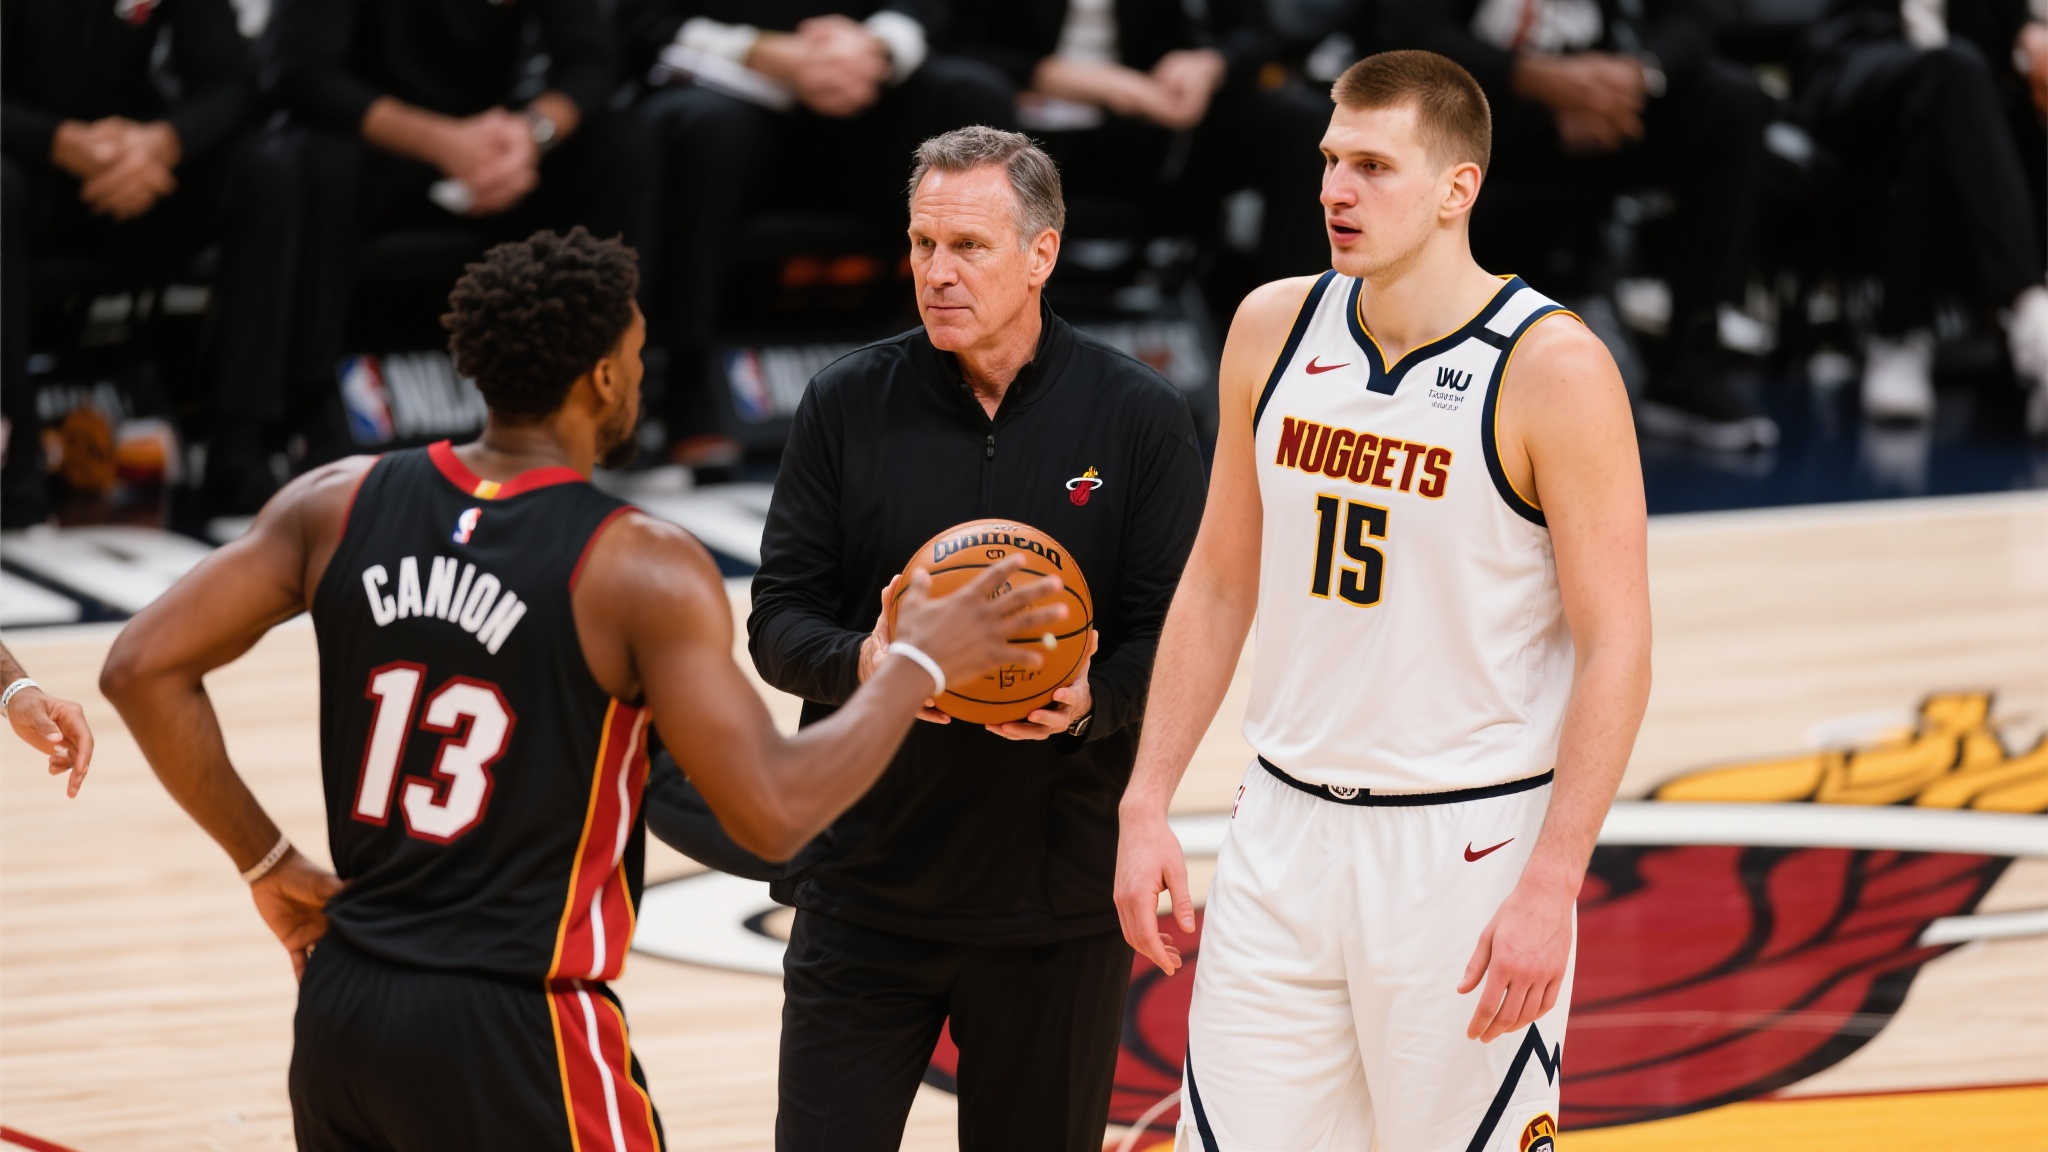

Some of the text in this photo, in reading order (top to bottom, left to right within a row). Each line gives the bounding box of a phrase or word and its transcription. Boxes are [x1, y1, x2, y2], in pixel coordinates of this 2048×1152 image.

[1274, 416, 1453, 500] NUGGETS
[1310, 493, 1390, 608] 15
[362, 555, 528, 655] CANION
[351, 659, 519, 846] 13
